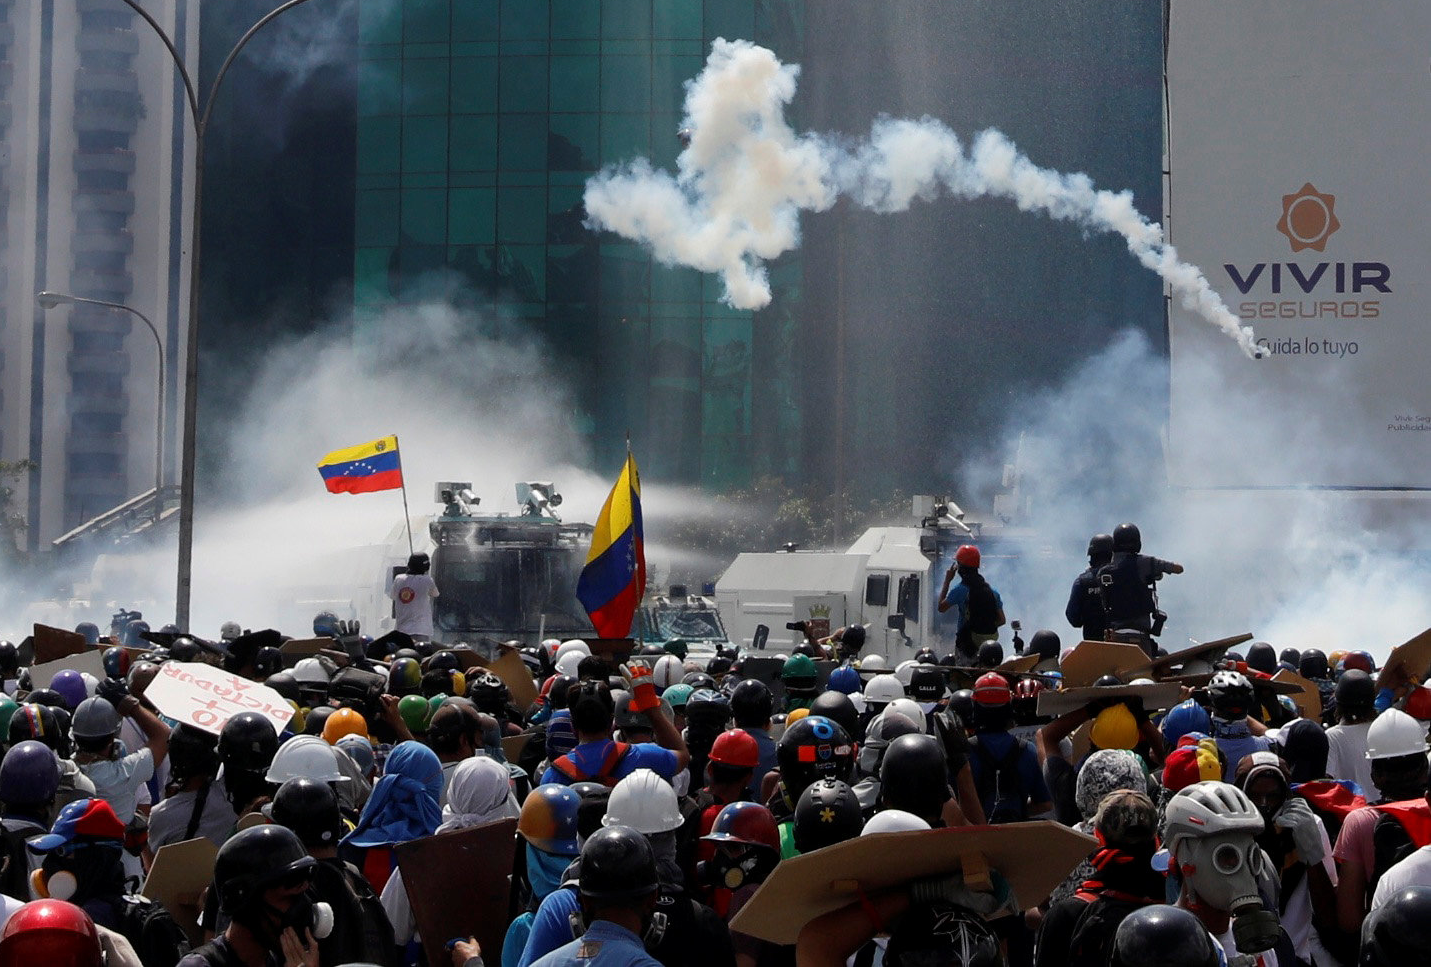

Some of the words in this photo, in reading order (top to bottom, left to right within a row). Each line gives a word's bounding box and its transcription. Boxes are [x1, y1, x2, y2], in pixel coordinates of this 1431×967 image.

[1223, 262, 1393, 295] VIVIR
[1305, 337, 1319, 355] lo
[1323, 340, 1359, 359] tuyo
